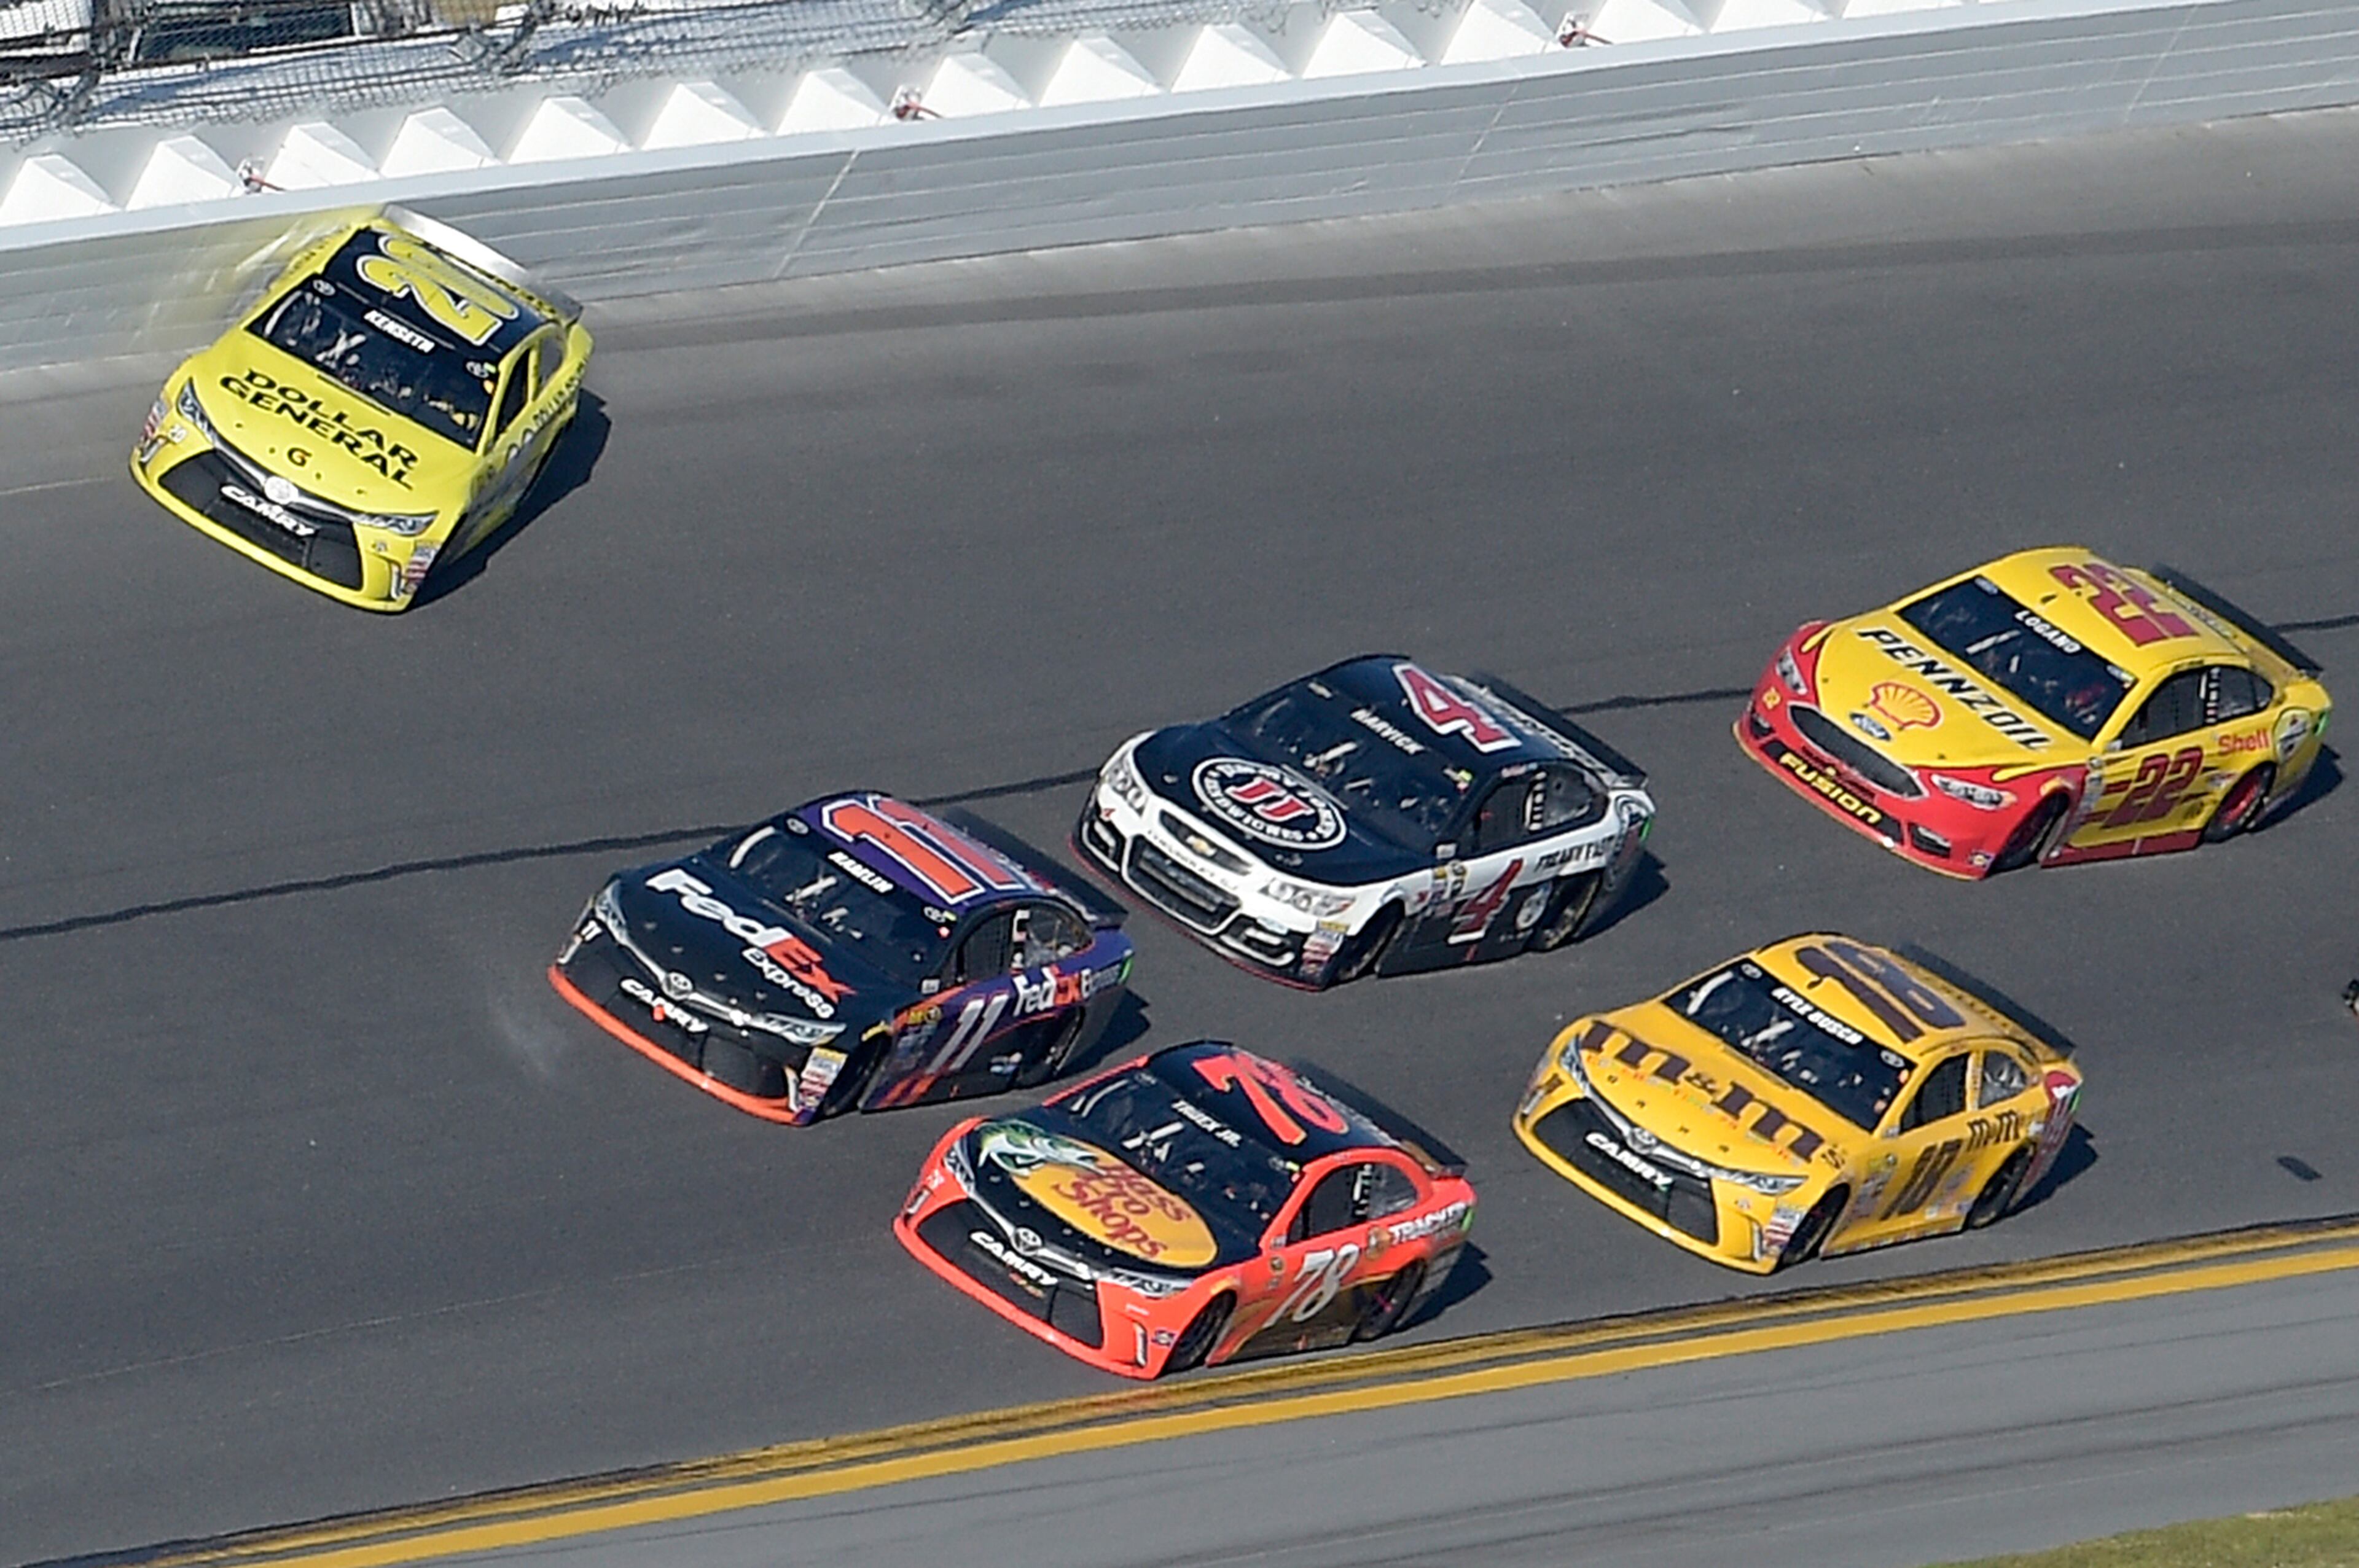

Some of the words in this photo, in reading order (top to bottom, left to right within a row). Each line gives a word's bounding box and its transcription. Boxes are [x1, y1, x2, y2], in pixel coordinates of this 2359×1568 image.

[364, 310, 435, 353] KENSETH
[219, 376, 413, 491] GENERAL
[243, 369, 418, 470] DOLLAR
[221, 485, 315, 536] CAMRY
[2014, 610, 2081, 653] LOGANO
[2049, 563, 2200, 647] 22
[1391, 663, 1523, 754] 4
[1857, 629, 2051, 751] PENNZOIL
[1350, 708, 1426, 755] HARVICK
[2218, 728, 2271, 756] Shell
[1779, 752, 1882, 824] FUSION
[2100, 745, 2204, 829] 22
[822, 795, 1026, 905] 11
[827, 852, 894, 893] HAMLIN
[646, 868, 857, 1004] FedEx
[1447, 857, 1524, 945] 4
[620, 978, 709, 1033] CAMRY
[741, 948, 834, 1019] Express
[1011, 964, 1082, 1017] FedEx
[1771, 986, 1814, 1016] KYLE
[1807, 1010, 1864, 1045] BUSCH
[925, 994, 1009, 1074] 11
[1585, 1131, 1673, 1185] CAMRY
[1050, 1180, 1168, 1258] Shops
[970, 1231, 1058, 1285] CAMRY
[1261, 1243, 1360, 1329] 78
